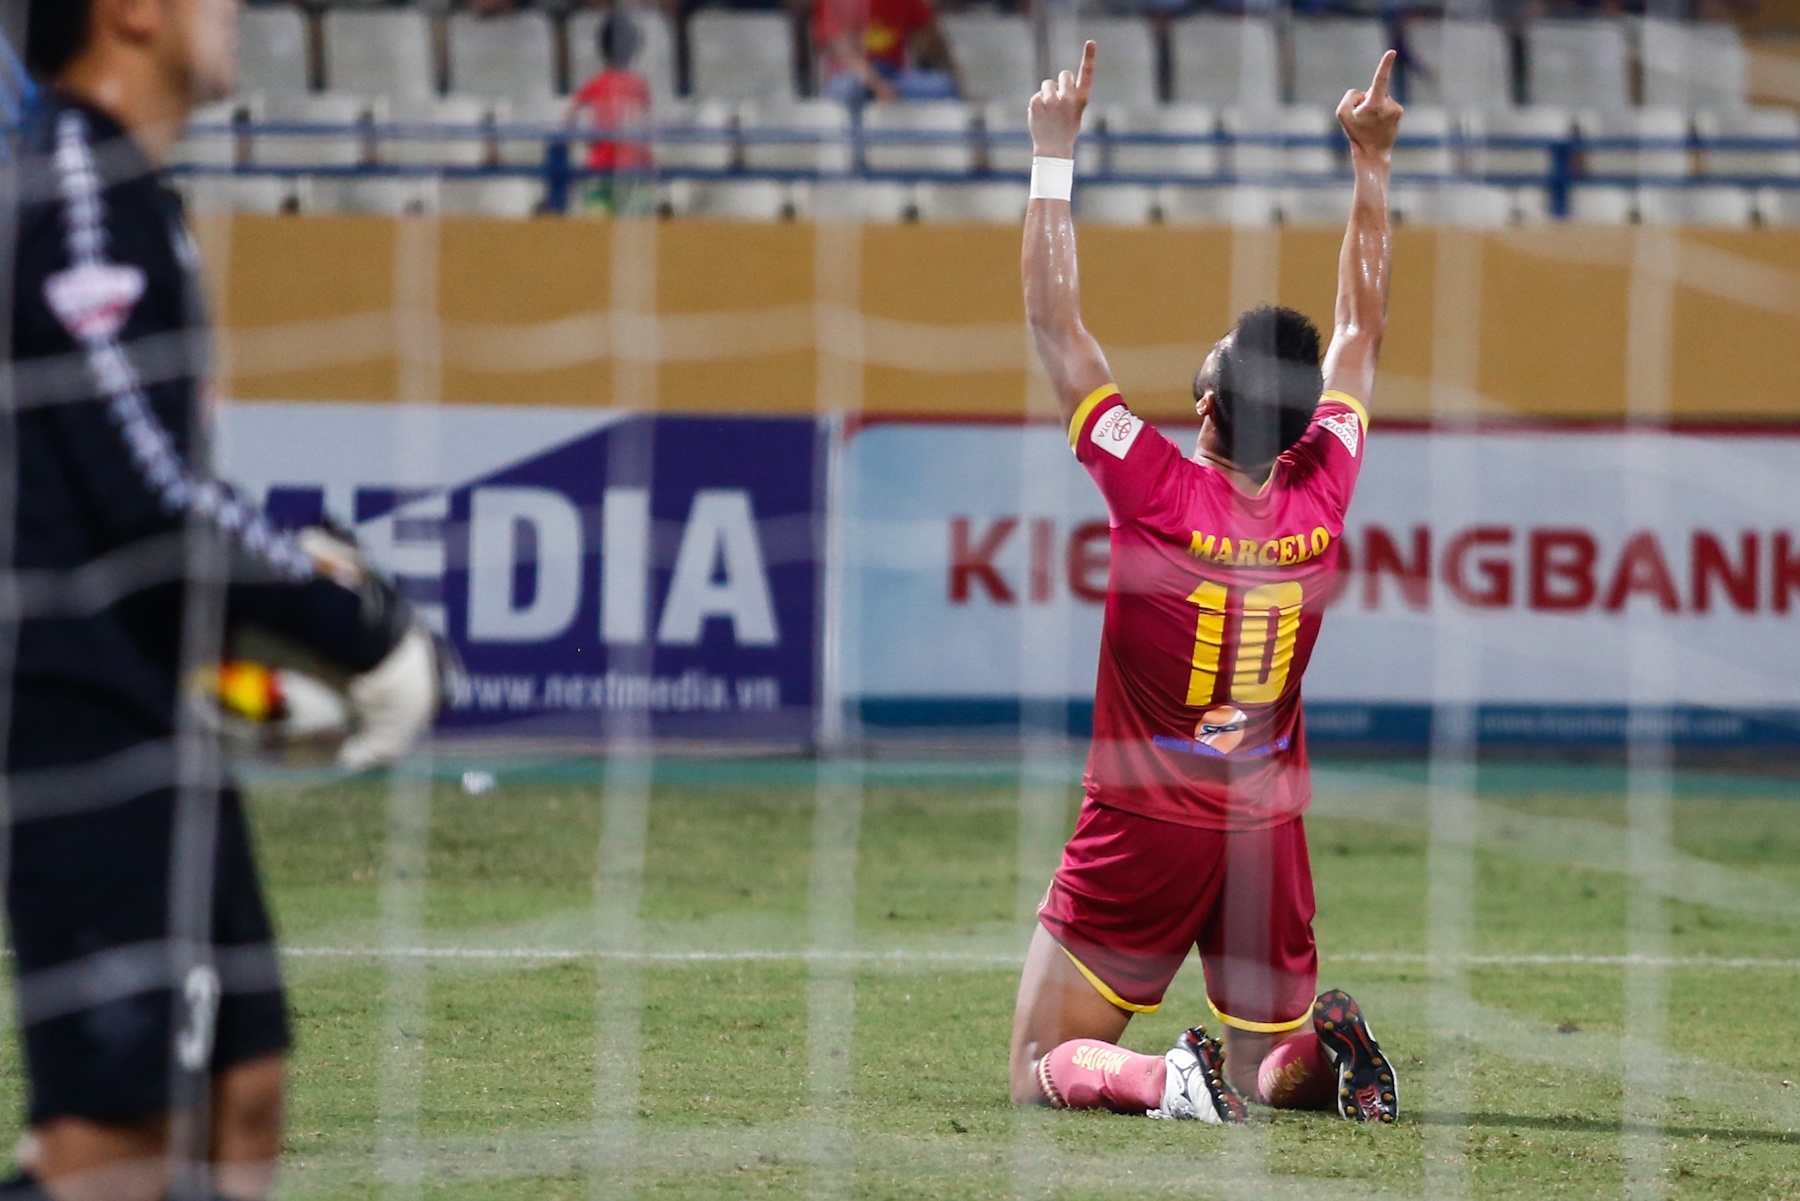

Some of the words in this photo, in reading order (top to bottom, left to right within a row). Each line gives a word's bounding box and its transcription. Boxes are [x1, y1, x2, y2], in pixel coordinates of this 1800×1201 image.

[265, 485, 778, 645] EDIA
[1187, 526, 1330, 567] MARCELO
[1184, 580, 1304, 706] 10
[1071, 1045, 1132, 1075] SAIGON
